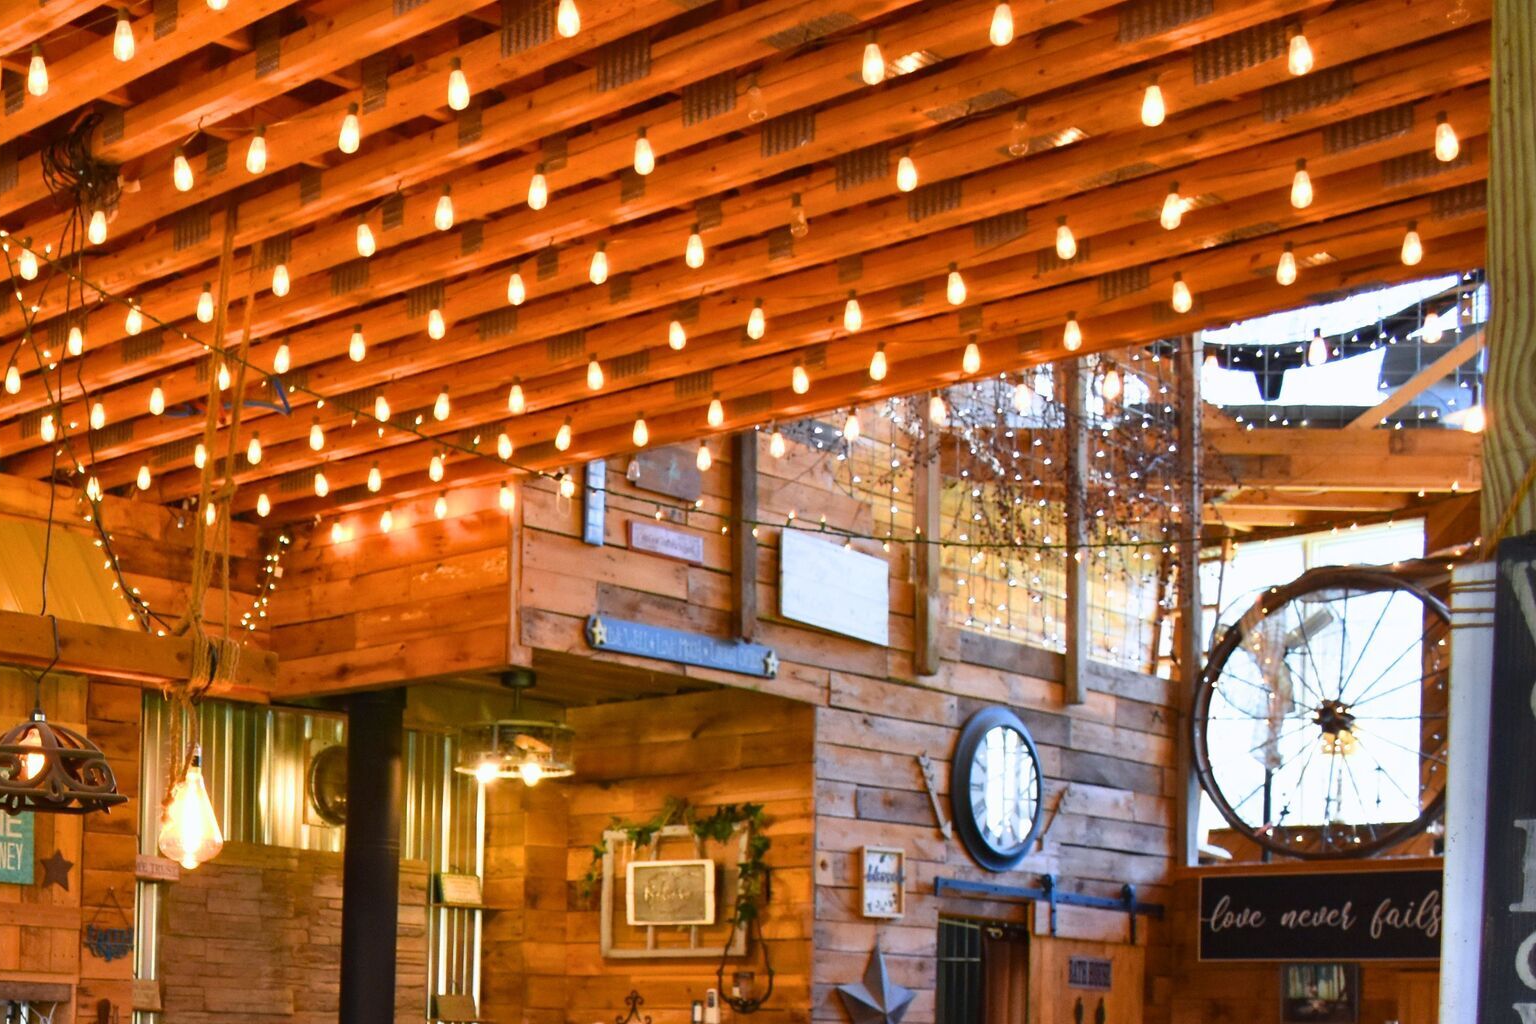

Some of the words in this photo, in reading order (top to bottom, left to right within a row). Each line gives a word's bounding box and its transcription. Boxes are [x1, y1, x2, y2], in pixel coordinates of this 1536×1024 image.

[1206, 895, 1266, 932] love
[1280, 901, 1357, 931] never
[1370, 890, 1443, 939] fails
